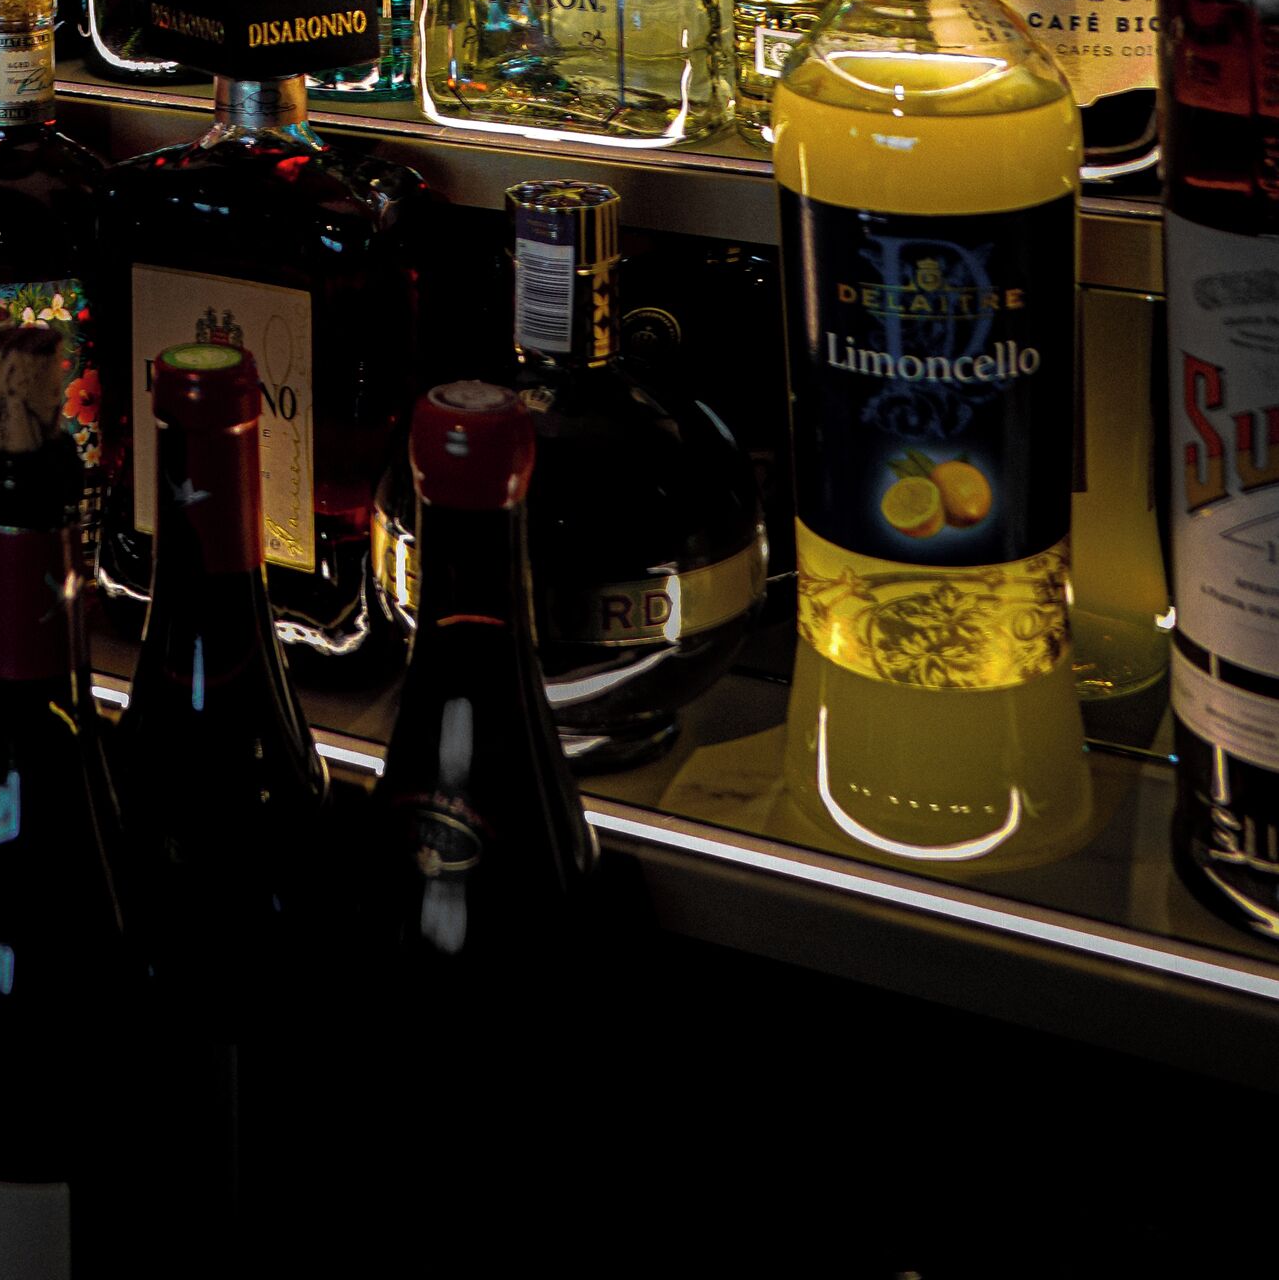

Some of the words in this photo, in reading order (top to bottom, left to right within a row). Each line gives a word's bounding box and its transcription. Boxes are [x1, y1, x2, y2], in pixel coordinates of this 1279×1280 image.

[247, 9, 368, 49] DISARONNO
[1028, 12, 1099, 32] CAFÉ
[837, 283, 1027, 313] DELAITRE
[827, 332, 1041, 384] Limoncello
